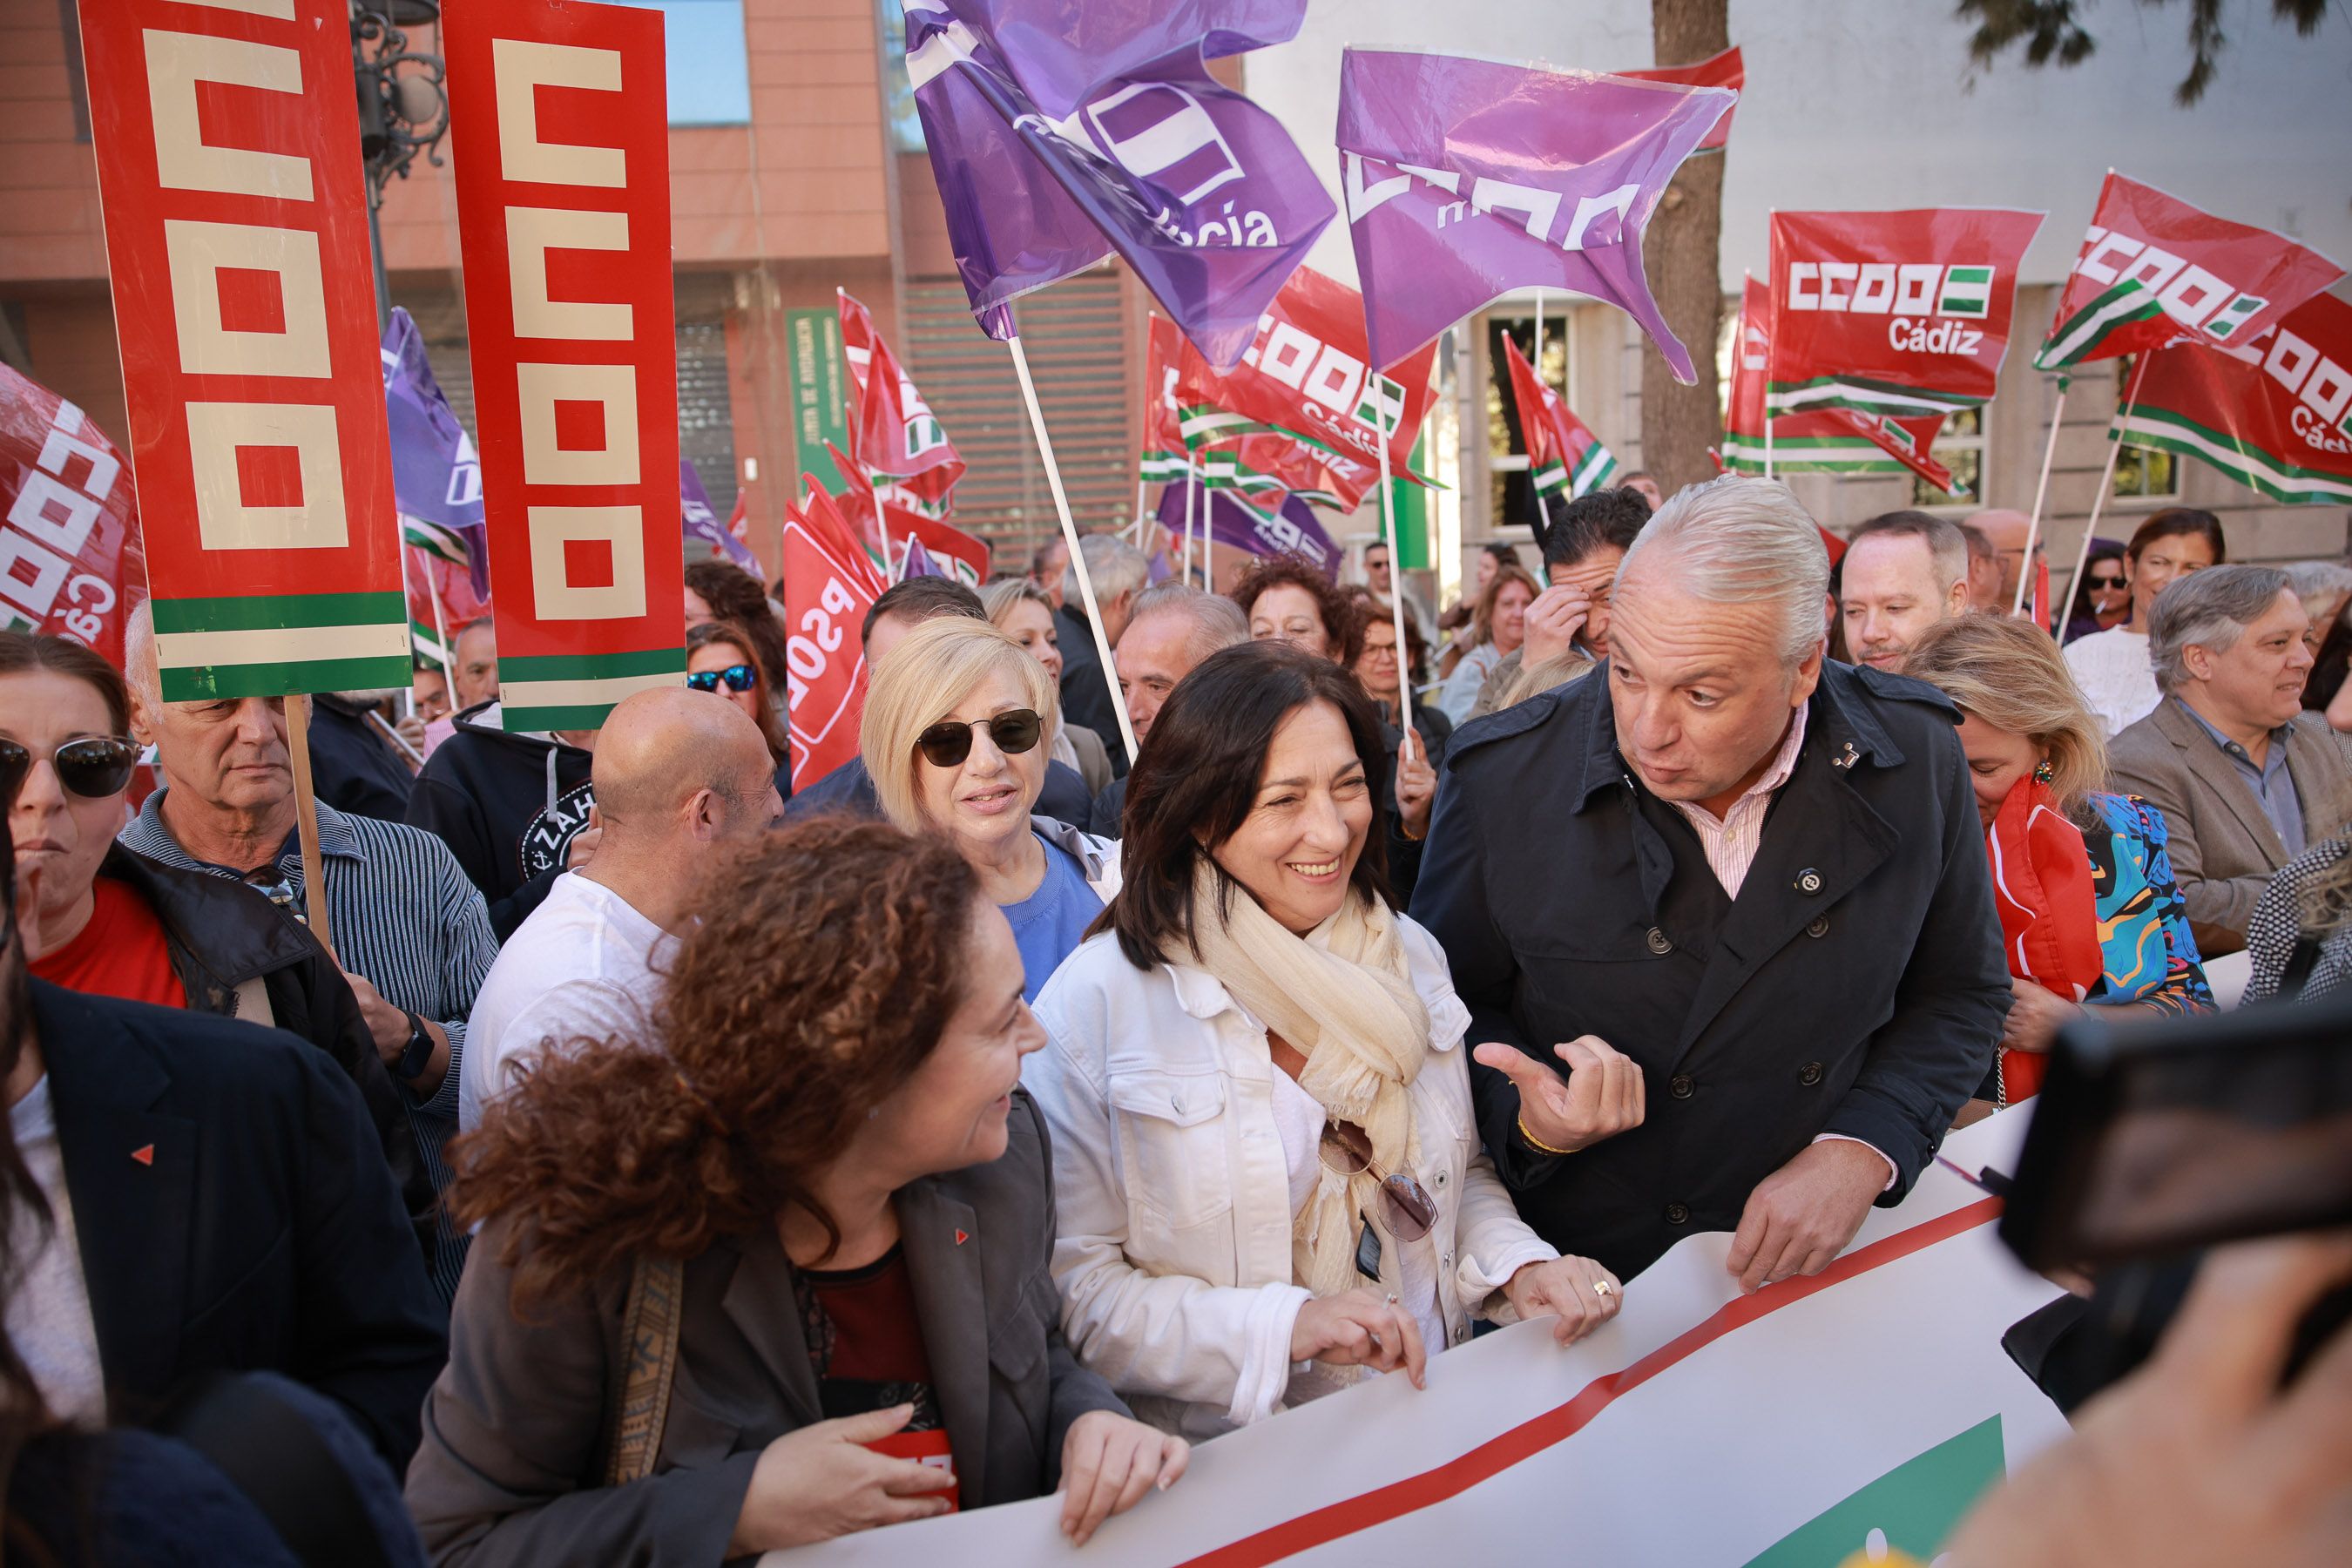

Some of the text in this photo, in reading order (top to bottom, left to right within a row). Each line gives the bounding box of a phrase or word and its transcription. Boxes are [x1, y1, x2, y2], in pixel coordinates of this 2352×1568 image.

[143, 0, 348, 551] COO
[1788, 261, 1944, 316] CCOO
[492, 38, 647, 621] CCOO
[1889, 317, 1984, 356] Cádiz
[533, 793, 595, 850] ZAH
